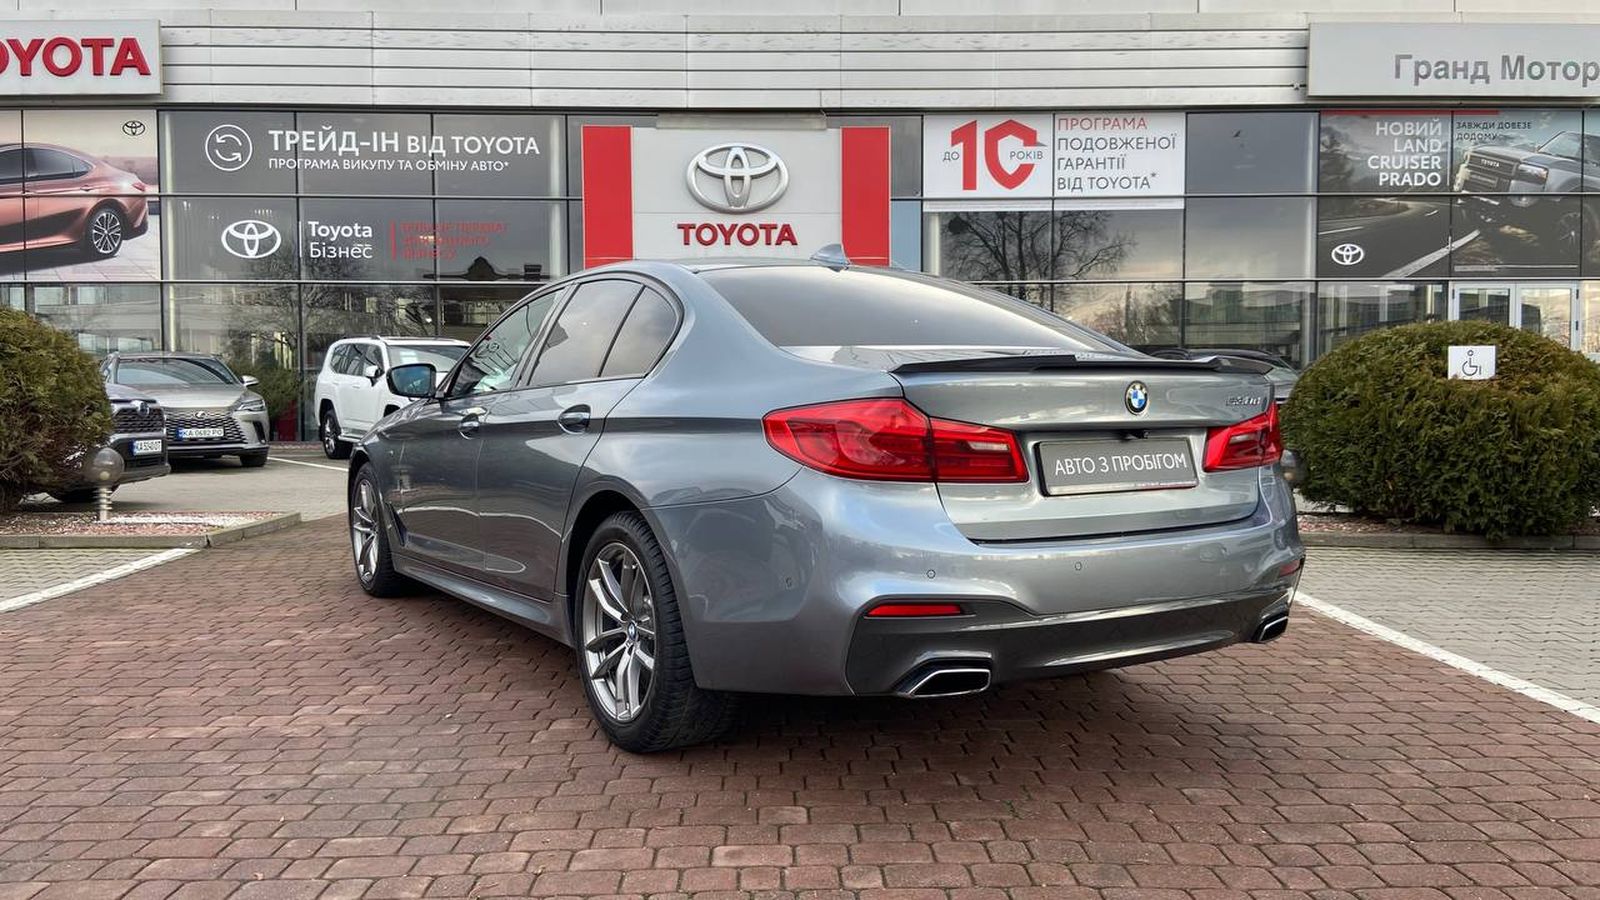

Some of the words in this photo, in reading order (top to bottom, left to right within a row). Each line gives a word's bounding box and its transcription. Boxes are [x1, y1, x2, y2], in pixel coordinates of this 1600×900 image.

[0, 36, 151, 77] YOTA
[1394, 54, 1490, 86] Гранд
[1058, 117, 1148, 131] ПРОГРАМА
[1375, 118, 1442, 137] НОВИЙ
[1456, 121, 1495, 130] ЗАВЖДИ
[1497, 121, 1532, 130] ДОВЕЗЕ
[268, 125, 399, 157] ТРЕЙД-ІН
[407, 135, 446, 157] ВІД
[451, 136, 540, 154] TOYOTA
[1058, 133, 1178, 152] ПОДОВЖЕНОЇ
[1456, 132, 1497, 141] ДОДОМУ
[1393, 139, 1442, 153] LAND
[268, 158, 340, 170] ПРОГРАМА
[343, 159, 395, 171] ВИКУПУ
[398, 160, 413, 170] ТА
[415, 160, 468, 172] ОБМІНУ
[943, 151, 960, 162] ДО
[1009, 151, 1044, 161] РОКІВ
[1057, 154, 1126, 171] ГАРАНТІЇ
[1367, 155, 1441, 170] CRUISER
[1057, 176, 1083, 192] ВІД
[1378, 172, 1442, 187] PRADO
[307, 221, 373, 241] Toyota
[677, 222, 798, 247] TOYOTA
[310, 242, 373, 259] Бізнес
[1055, 456, 1095, 476] АВТО
[1111, 453, 1187, 473] ПРОБІГОМ
